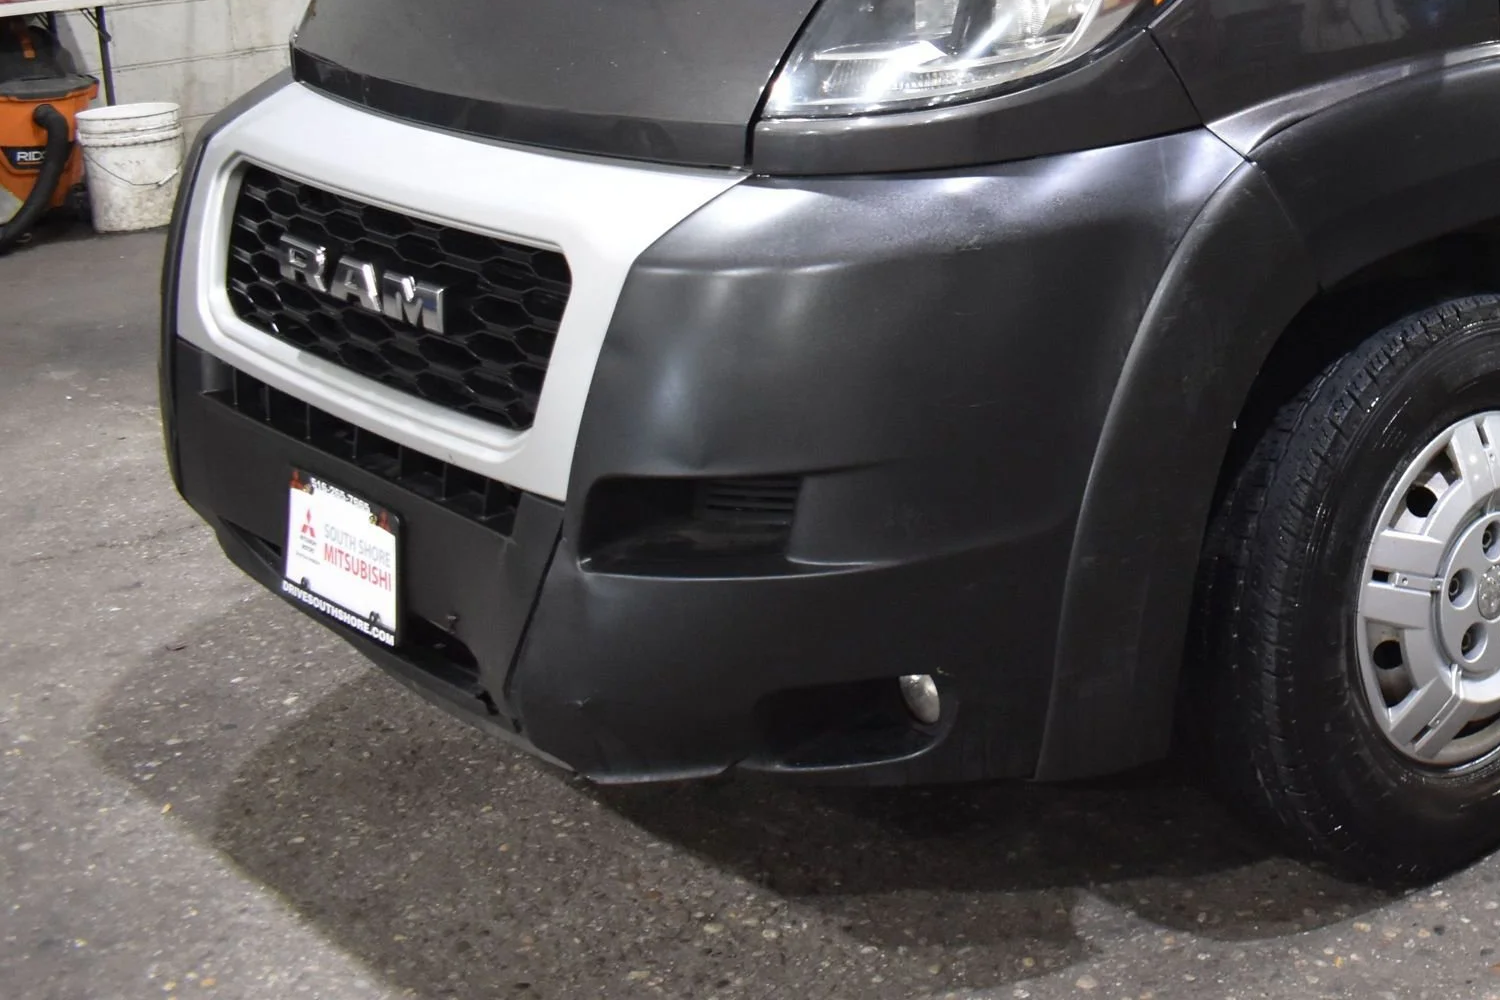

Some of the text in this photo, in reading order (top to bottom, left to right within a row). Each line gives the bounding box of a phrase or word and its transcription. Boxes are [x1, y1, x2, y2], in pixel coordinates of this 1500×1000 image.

[17, 151, 46, 161] RID
[280, 233, 446, 334] RAM
[323, 543, 392, 592] MITSUBISHI
[324, 523, 356, 552] SOUTH
[358, 538, 392, 568] SHORE
[281, 579, 396, 647] DRIVESOUTHSHORE.COM
